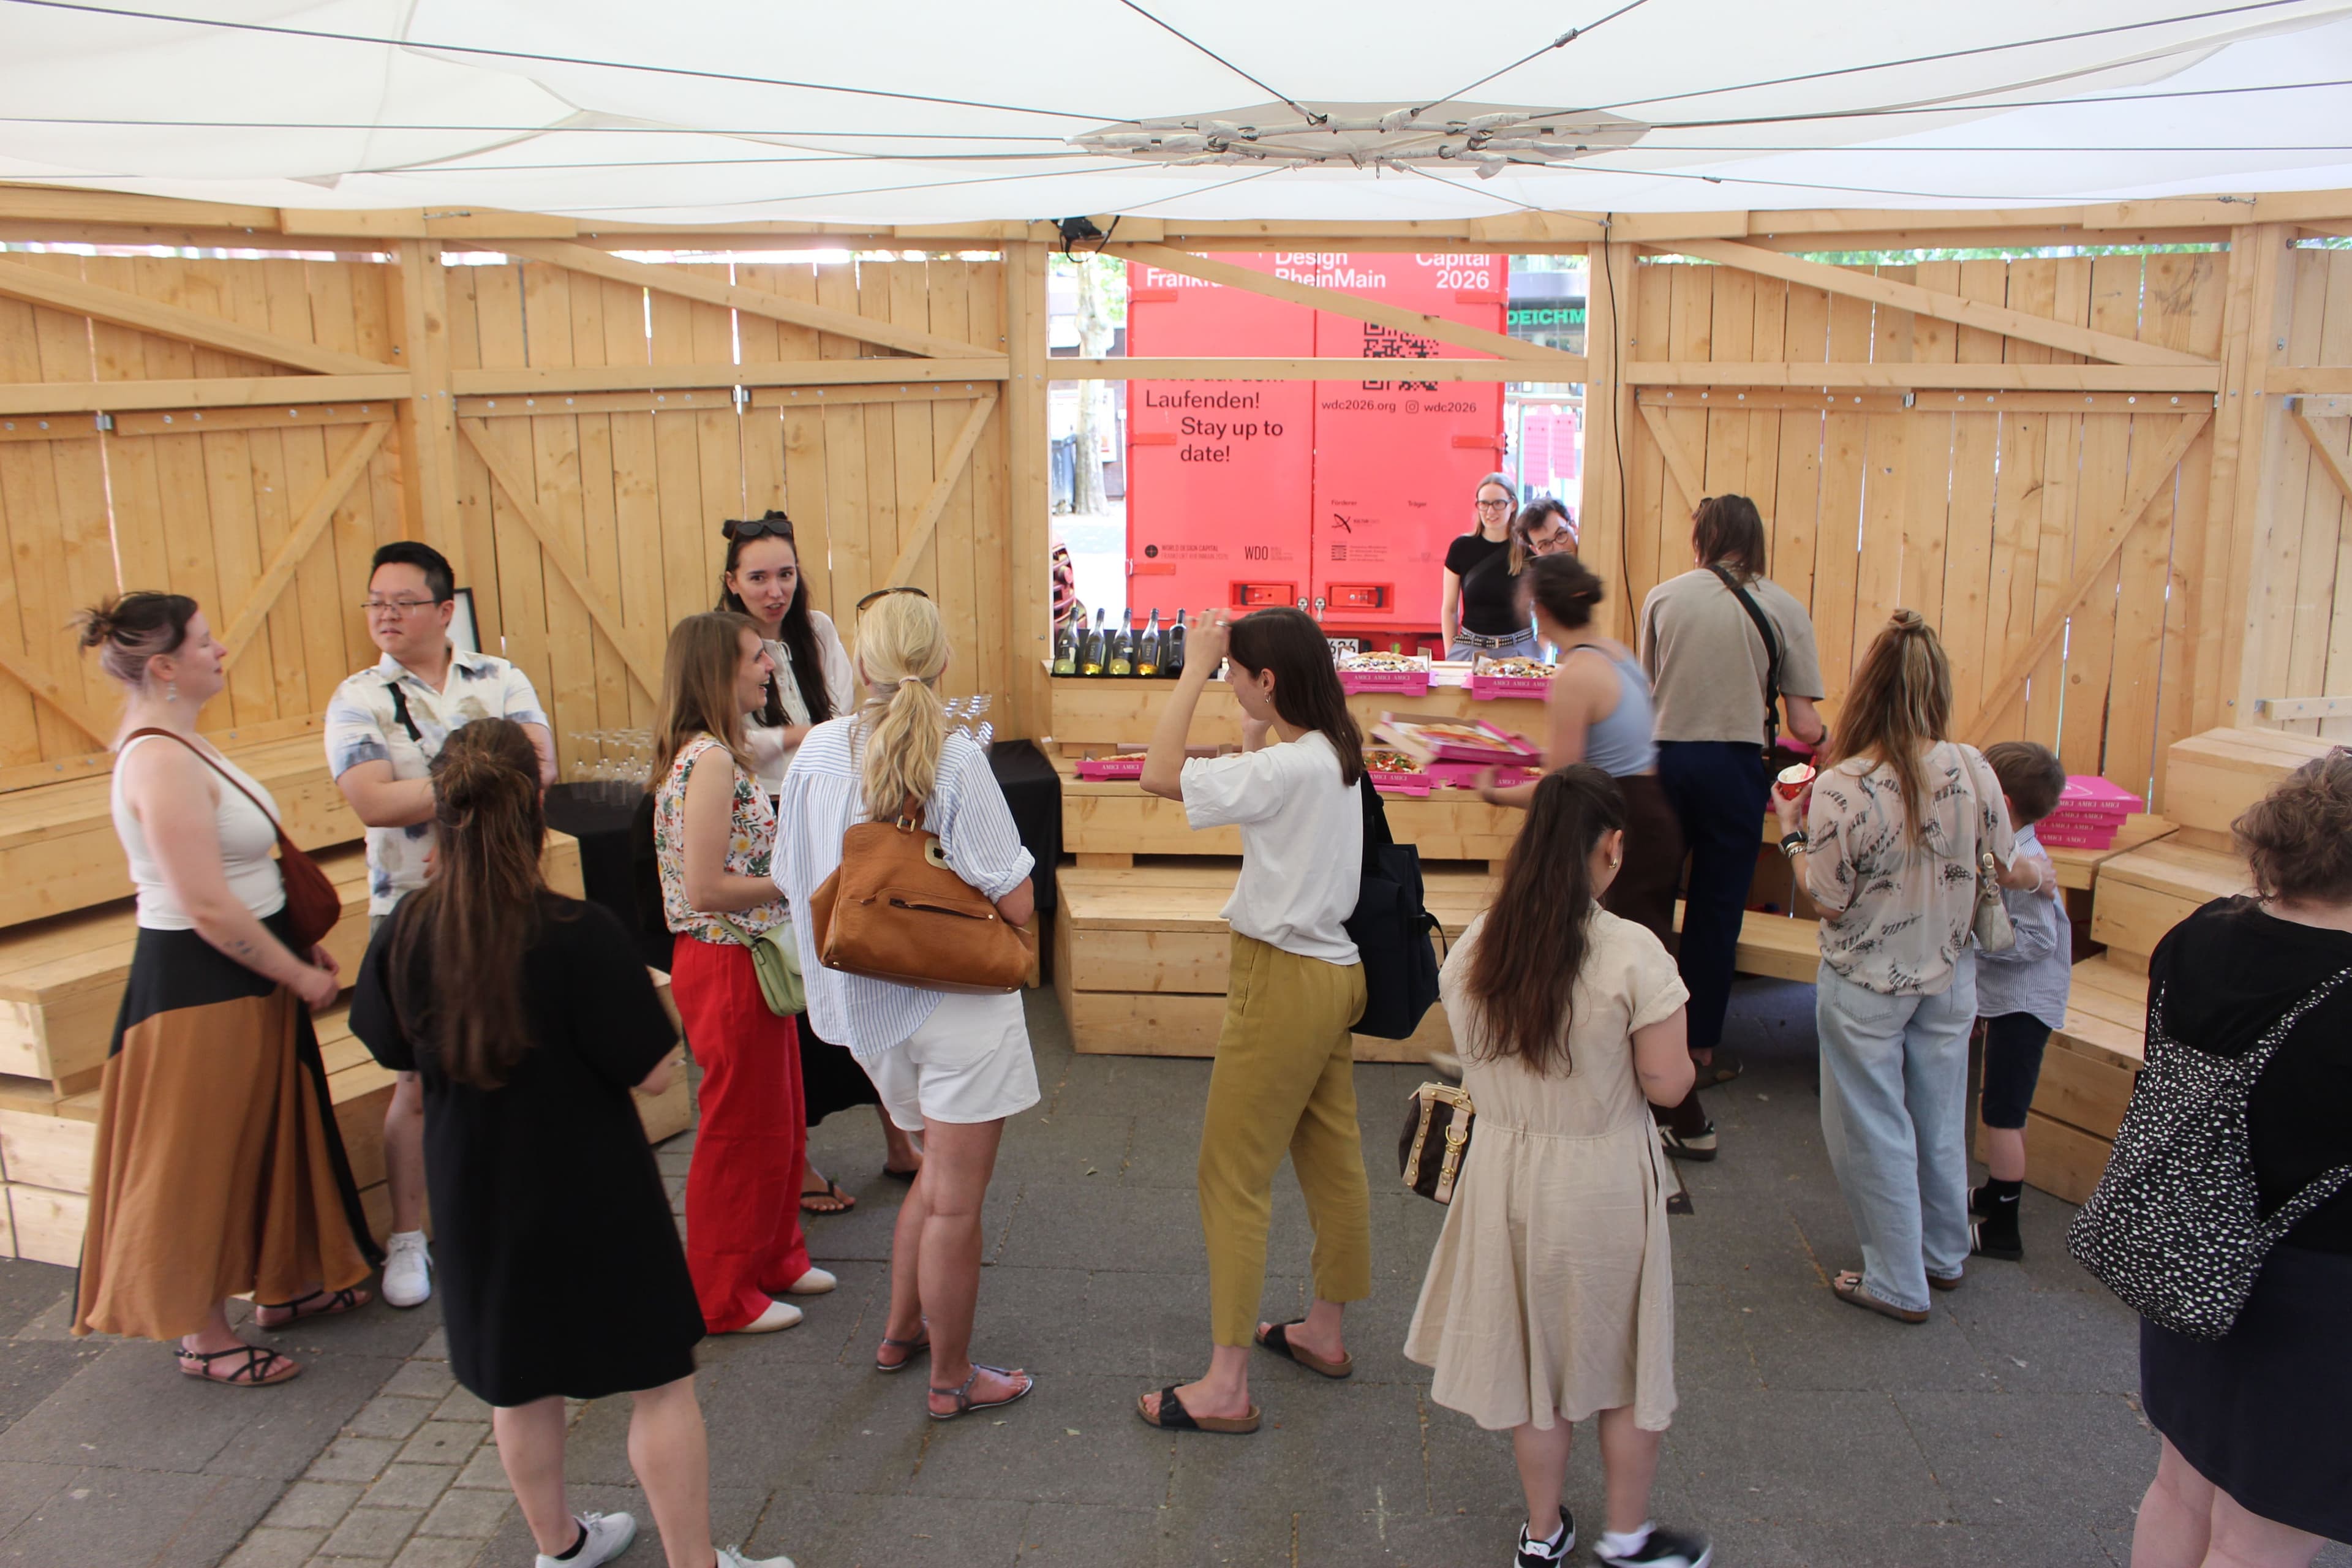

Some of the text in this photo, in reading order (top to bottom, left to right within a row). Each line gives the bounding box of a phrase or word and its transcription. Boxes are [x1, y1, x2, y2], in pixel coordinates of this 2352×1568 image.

[1275, 252, 1490, 270] Design Capital
[1275, 268, 1386, 288] RheinMain
[1436, 270, 1490, 289] 2026
[1146, 390, 1259, 409] Laufenden!
[1322, 399, 1477, 413] wdc2026.org wdc2026
[1181, 417, 1283, 440] Stay up to
[1180, 443, 1230, 462] date!
[1245, 546, 1268, 560] WDO
